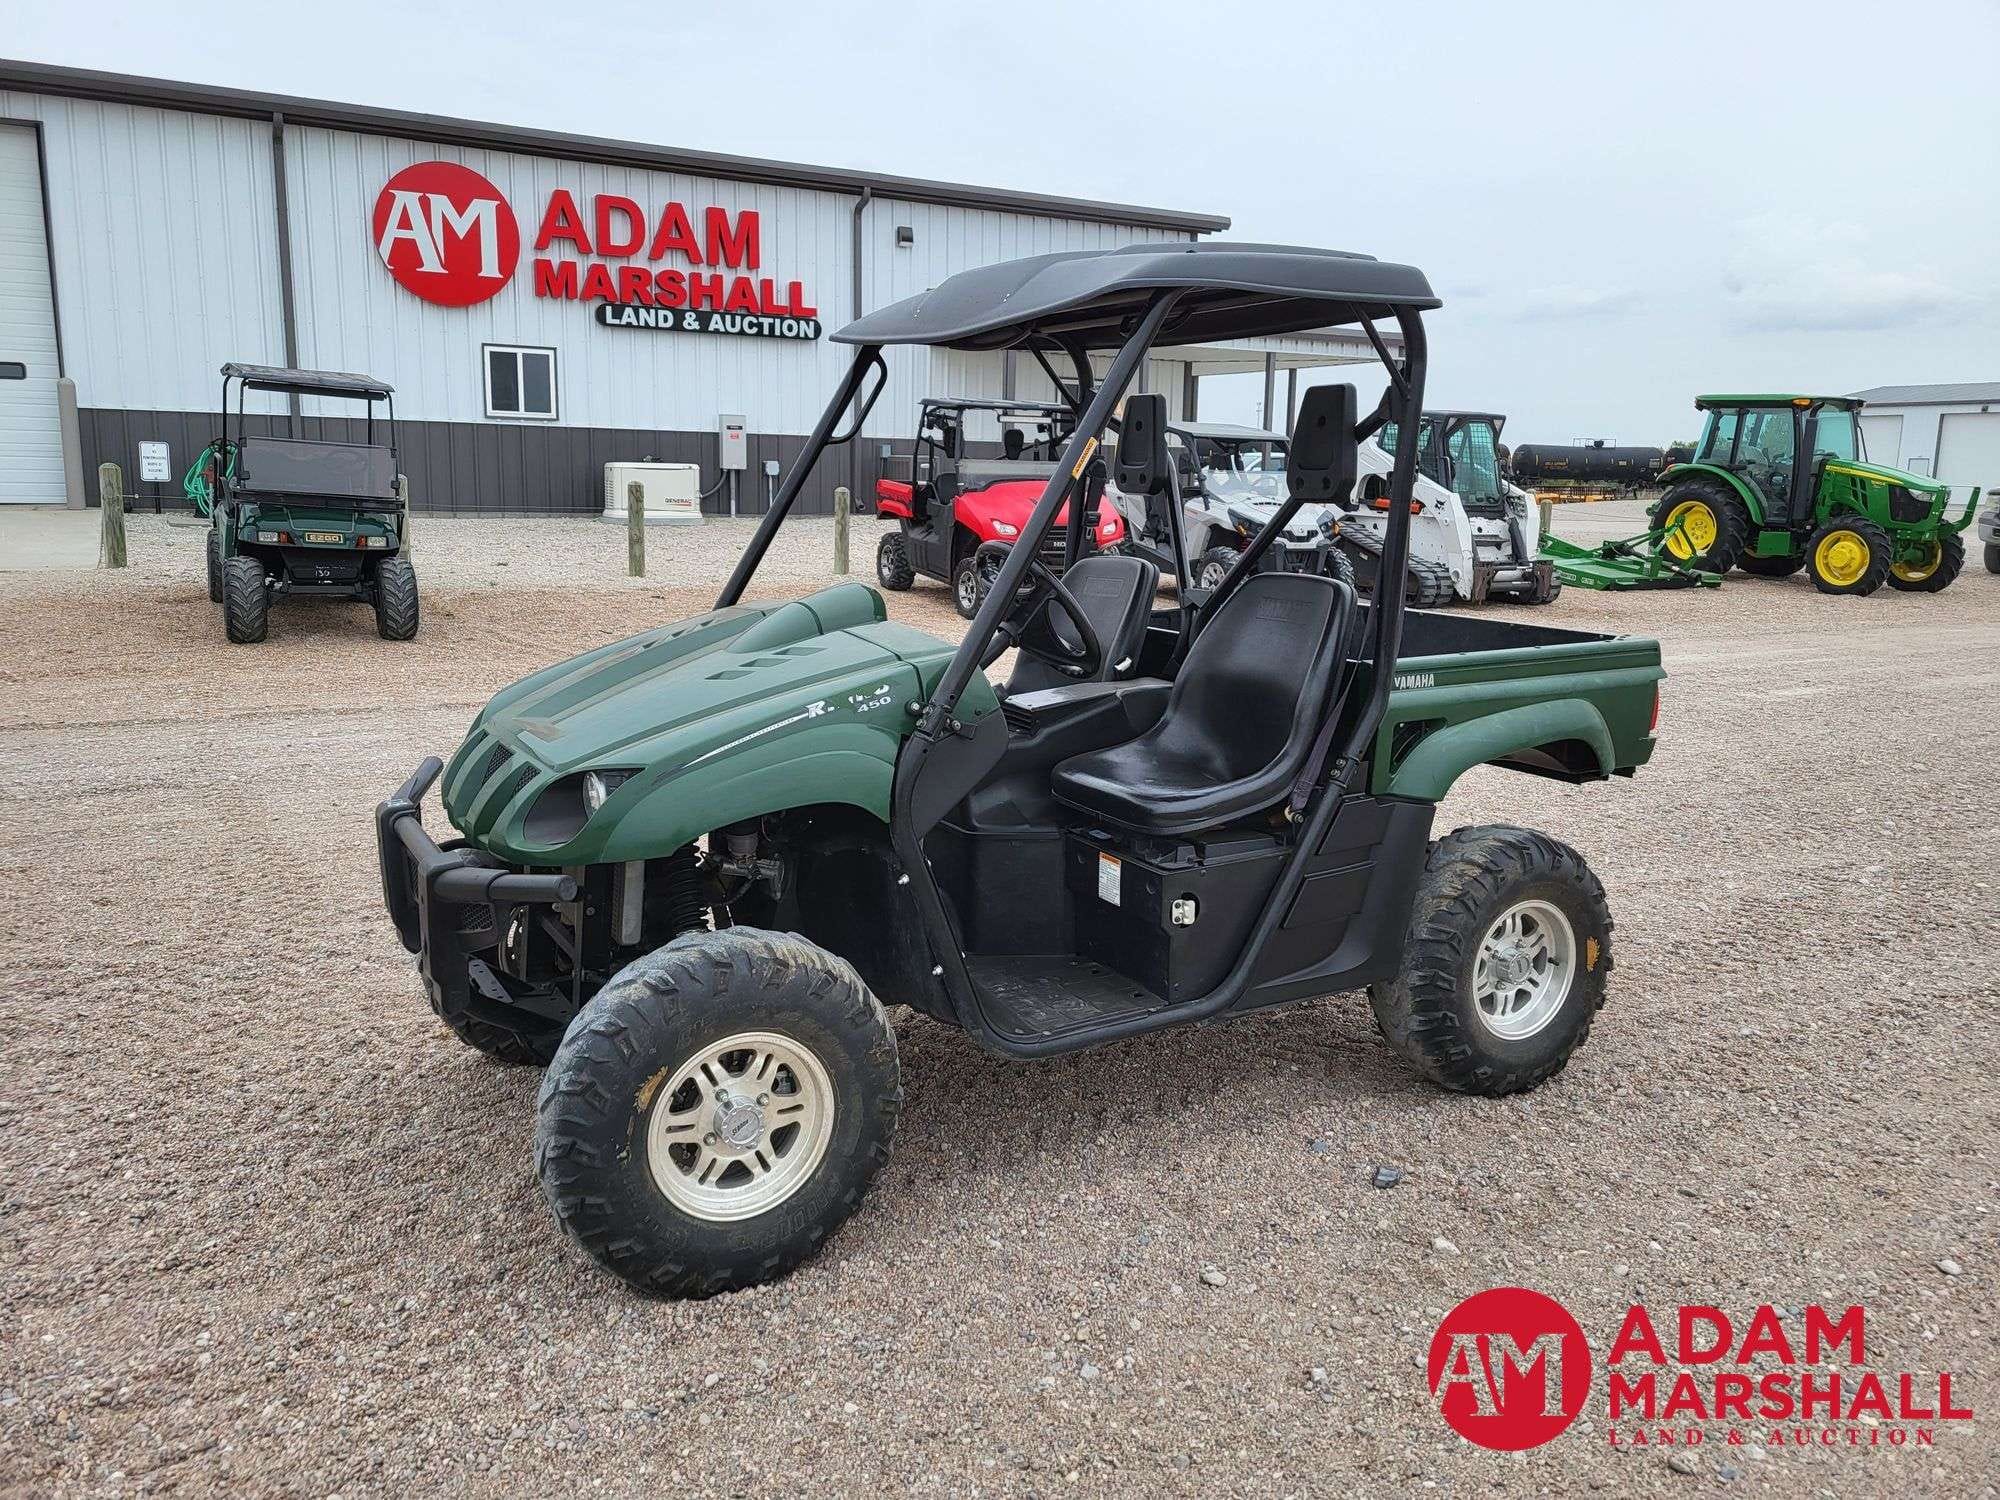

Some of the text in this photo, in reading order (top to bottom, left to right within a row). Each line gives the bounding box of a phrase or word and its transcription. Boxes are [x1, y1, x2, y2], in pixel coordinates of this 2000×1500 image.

[378, 189, 504, 278] AM
[534, 188, 760, 270] ADAM
[534, 258, 817, 318] MARSHALL
[605, 306, 815, 338] LAND & AUCTION
[857, 695, 891, 713] 450
[1394, 673, 1435, 690] YAMAHA
